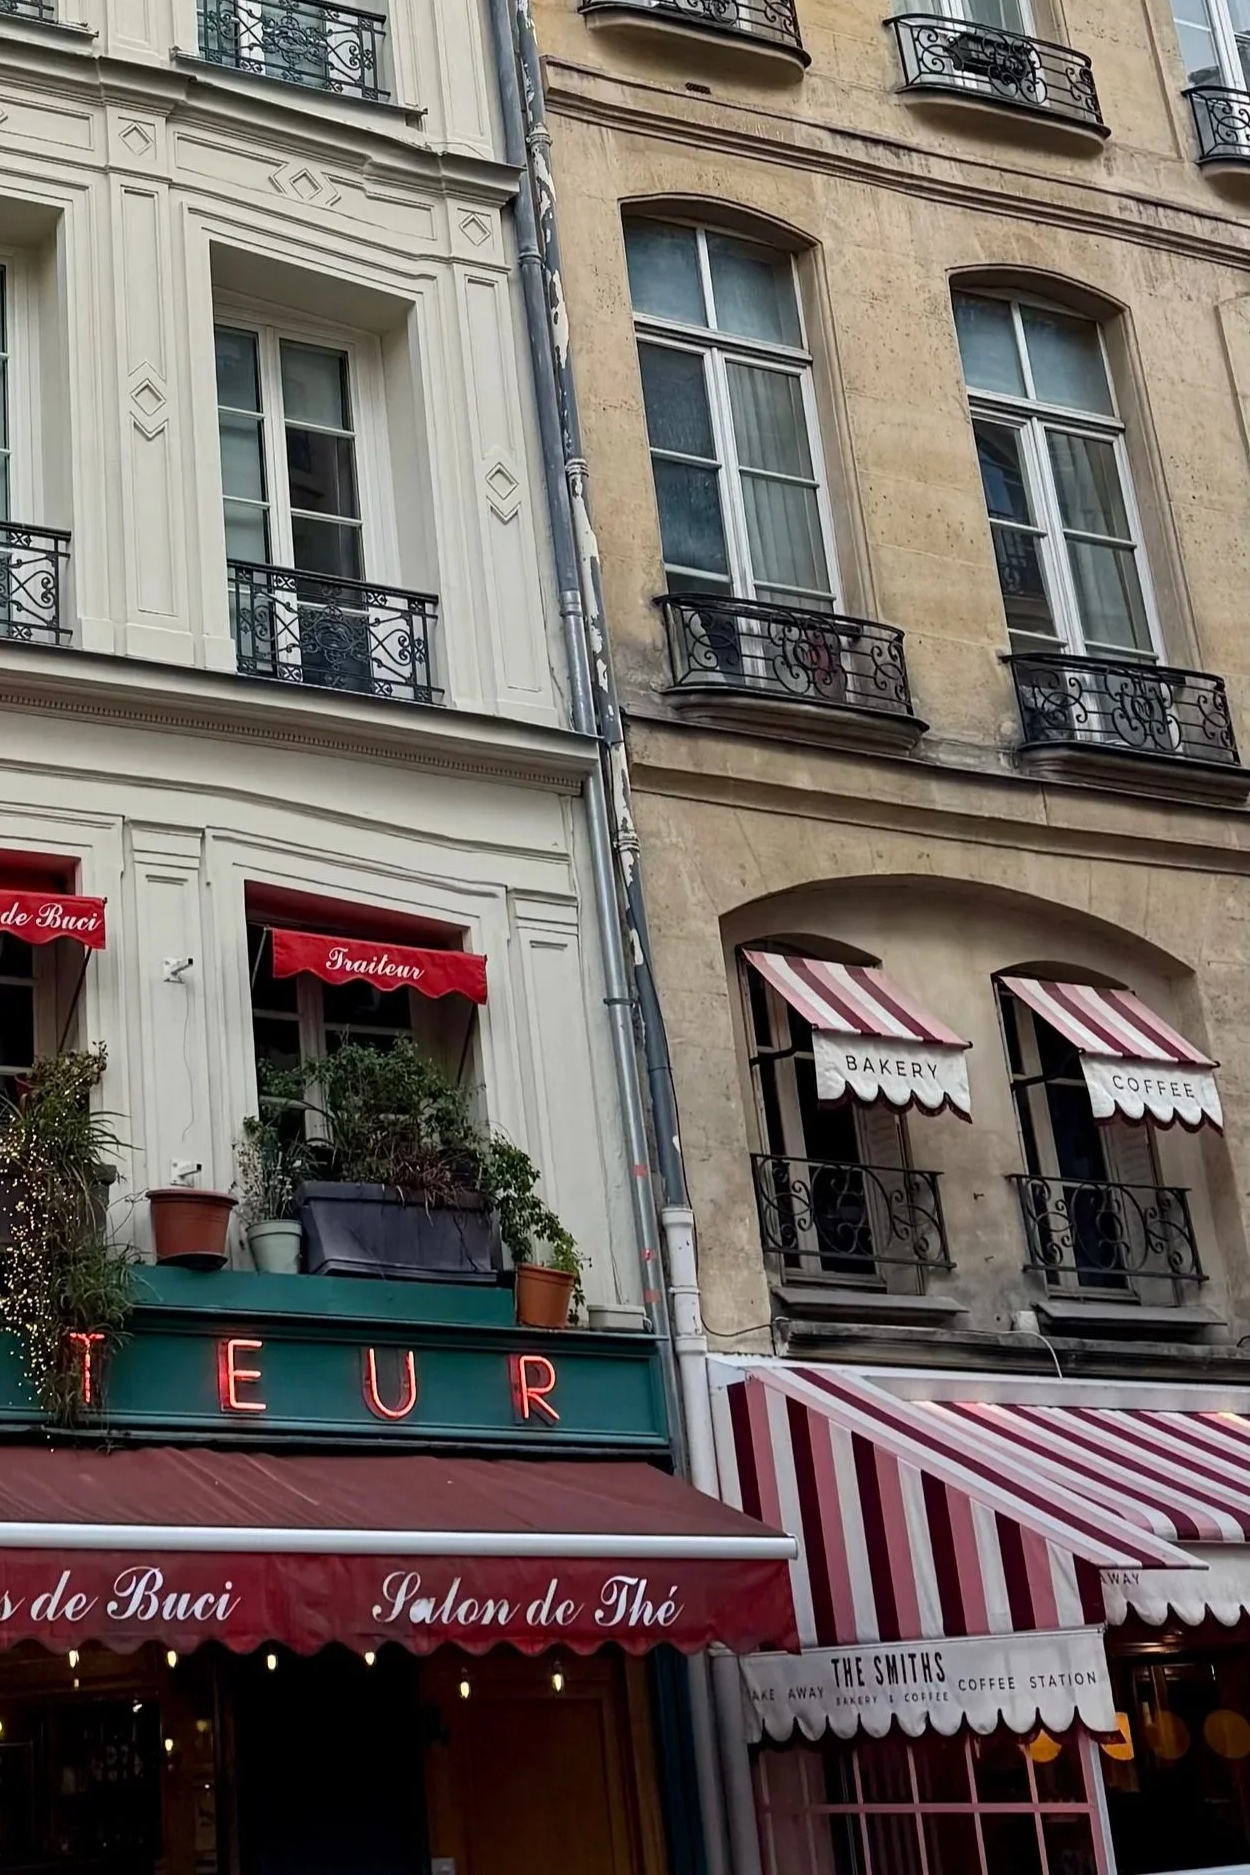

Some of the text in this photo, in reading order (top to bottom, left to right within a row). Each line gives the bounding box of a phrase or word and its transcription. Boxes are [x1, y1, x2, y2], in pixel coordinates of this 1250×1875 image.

[0, 902, 33, 926] de
[35, 902, 101, 931] Buci
[325, 946, 425, 980] Traiteur
[845, 1055, 937, 1079] BAKERY
[1112, 1075, 1195, 1098] COFFEE
[30, 1569, 99, 1621] de
[106, 1566, 242, 1621] Buci
[372, 1571, 685, 1627] Salon de Thé
[831, 1652, 946, 1689] THE SMITHS
[958, 1671, 1097, 1692] COFFEE STATION
[751, 1686, 823, 1702] AKE AWAY
[836, 1692, 877, 1707] BAKERY
[904, 1691, 949, 1703] COFFEE
